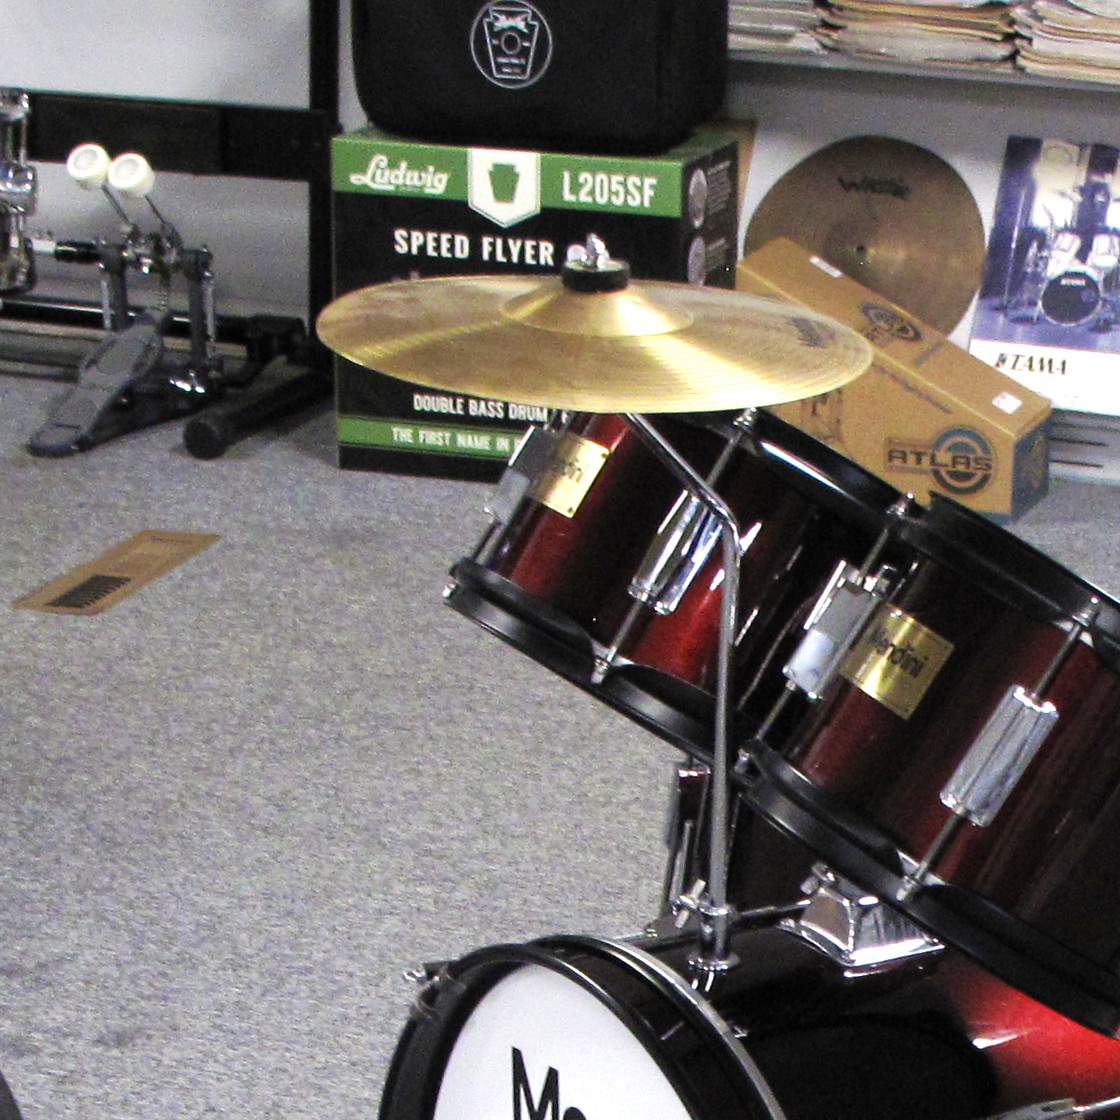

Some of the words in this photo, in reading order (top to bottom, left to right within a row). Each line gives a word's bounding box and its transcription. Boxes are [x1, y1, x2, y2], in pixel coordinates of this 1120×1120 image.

[350, 154, 450, 195] Ludwig
[562, 170, 658, 208] L205SF
[394, 229, 470, 259] SPEED
[482, 236, 555, 266] FLYER
[1010, 354, 1067, 375] TAMA
[413, 394, 464, 415] DOUBLE
[468, 400, 504, 419] BASS
[508, 404, 548, 422] DRUM
[392, 427, 413, 443] THE
[418, 430, 450, 446] FIRST
[456, 433, 490, 450] NAME
[496, 437, 510, 451] IN
[887, 449, 993, 471] ATLAS
